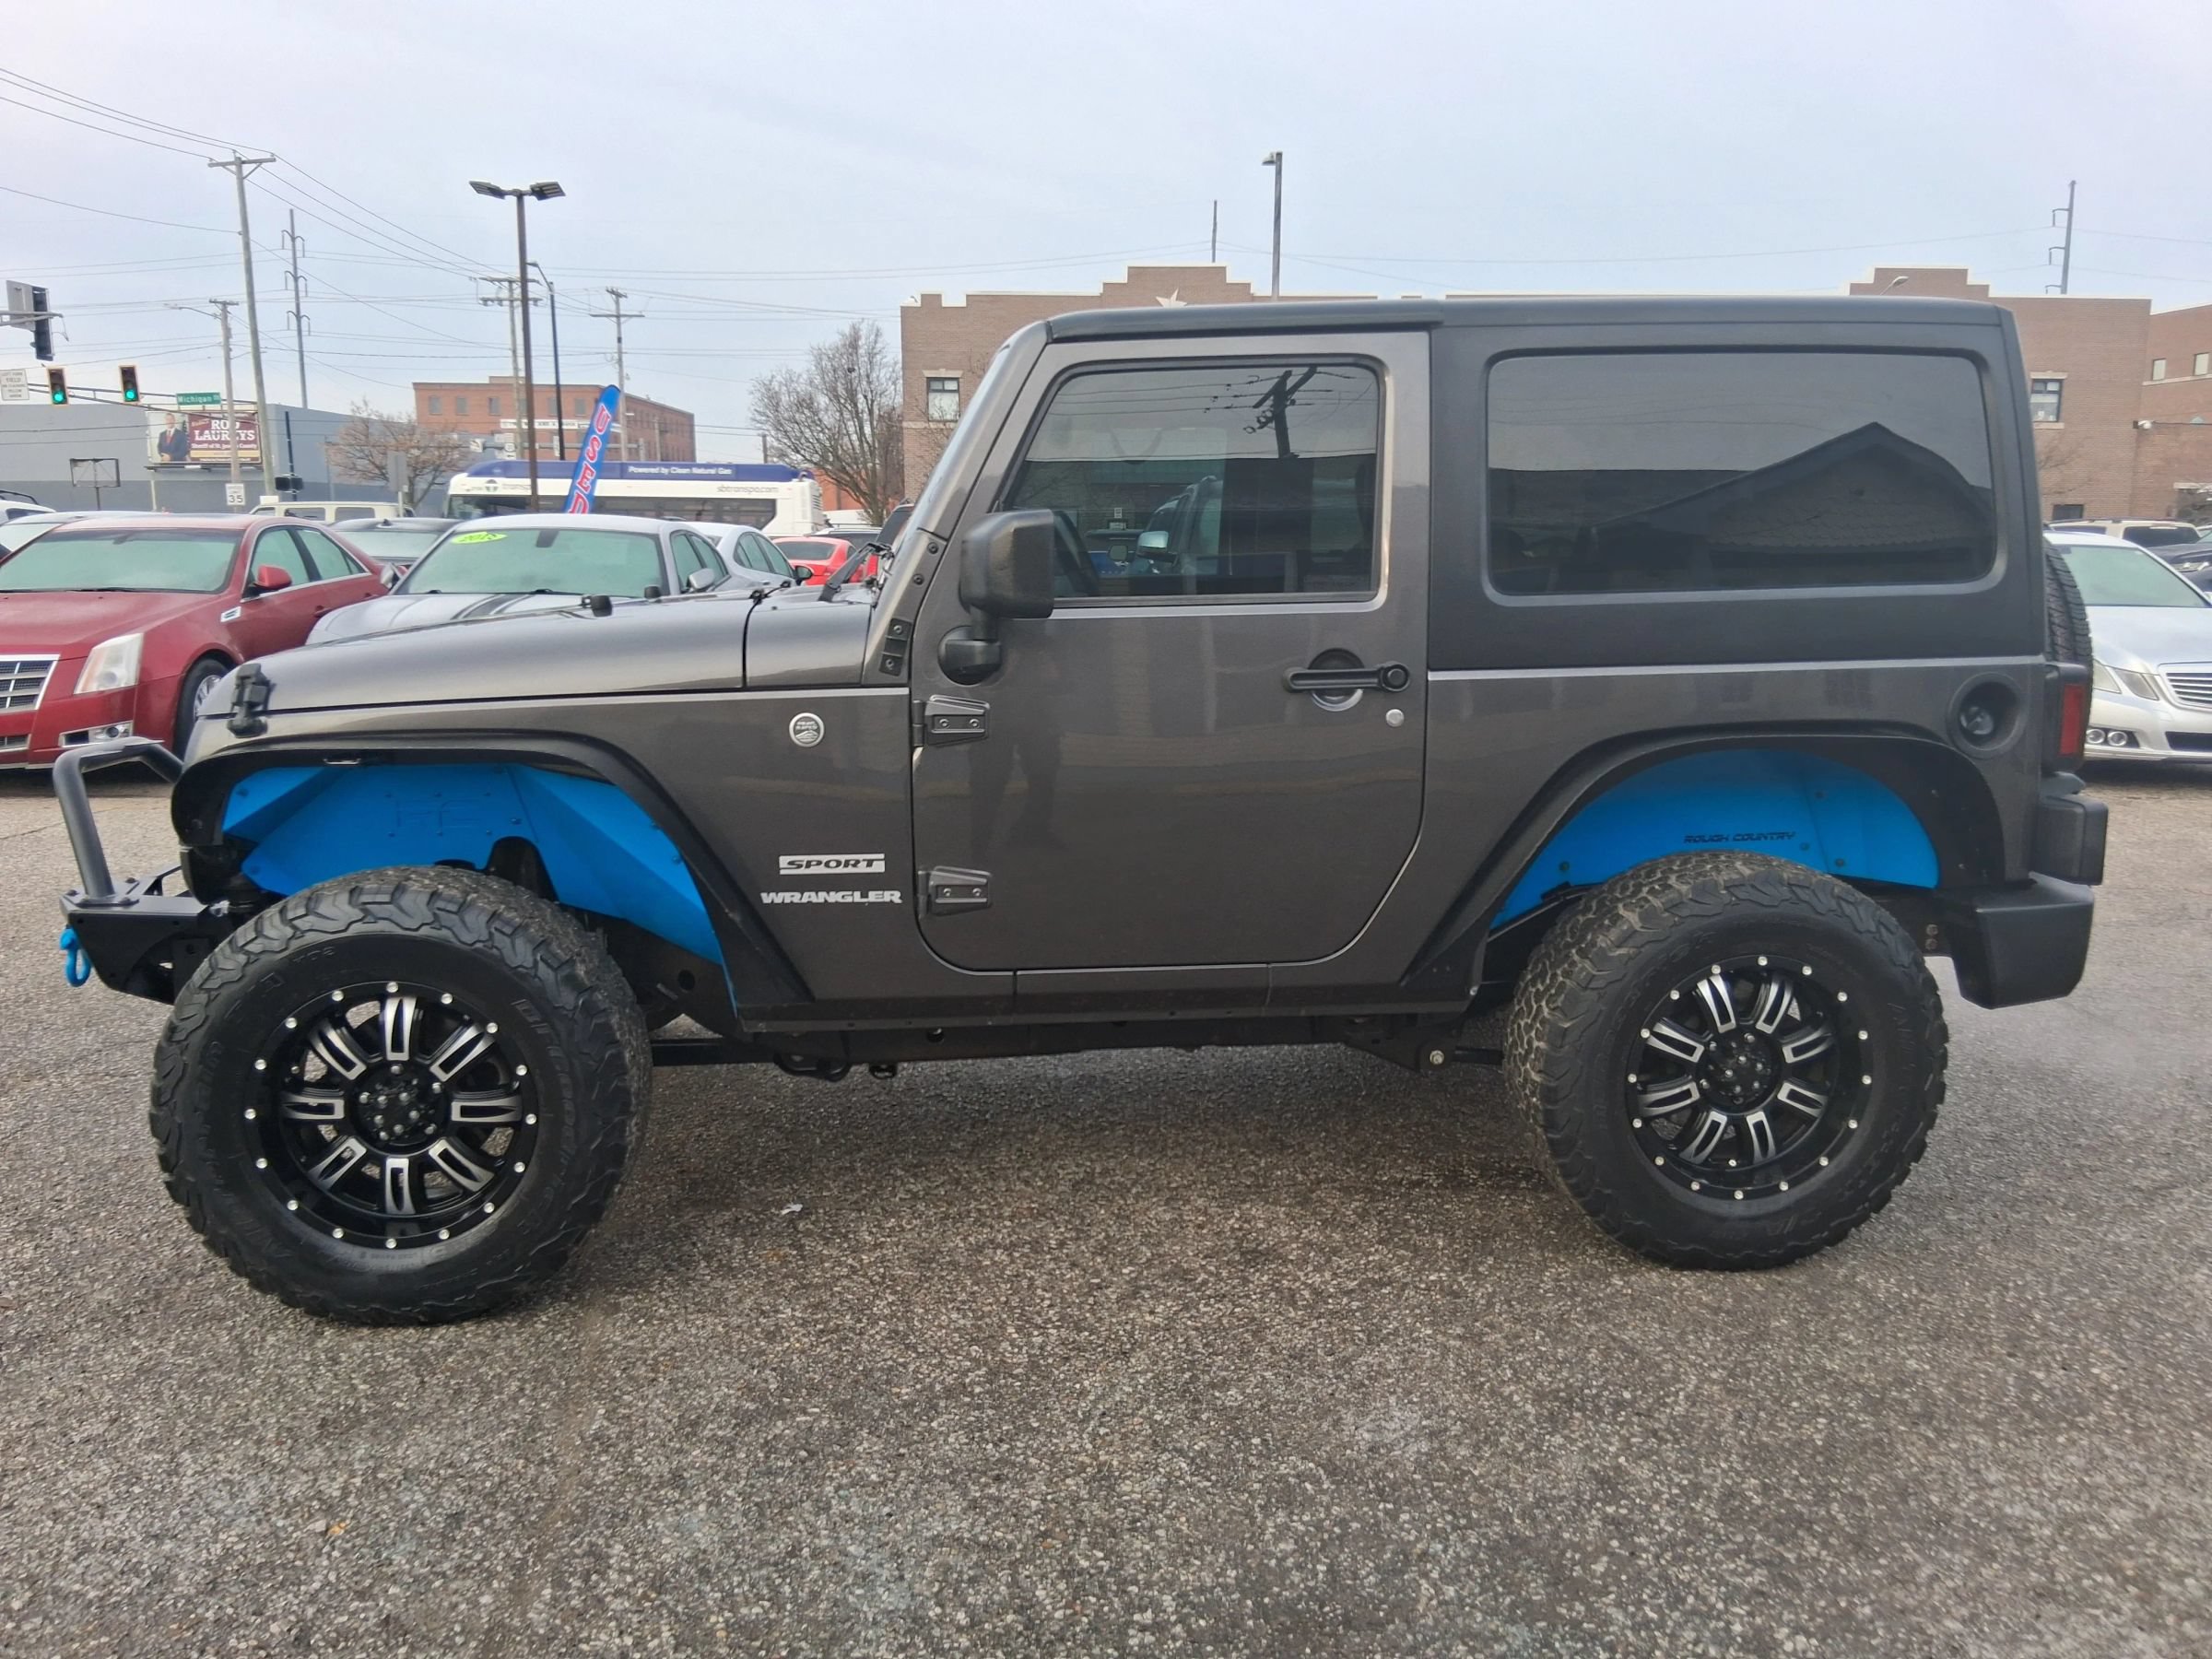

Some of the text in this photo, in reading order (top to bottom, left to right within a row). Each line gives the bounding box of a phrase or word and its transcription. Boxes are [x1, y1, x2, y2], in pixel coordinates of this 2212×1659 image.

[194, 429, 255, 441] LAURYS
[629, 465, 659, 474] Powered
[660, 466, 669, 475] by
[692, 466, 716, 475] Natural
[718, 466, 733, 475] Gas
[228, 494, 243, 503] 35
[1683, 831, 1795, 843] ROUGH COUNTRY
[782, 856, 880, 871] SPORT
[760, 889, 903, 904] WRANGLER
